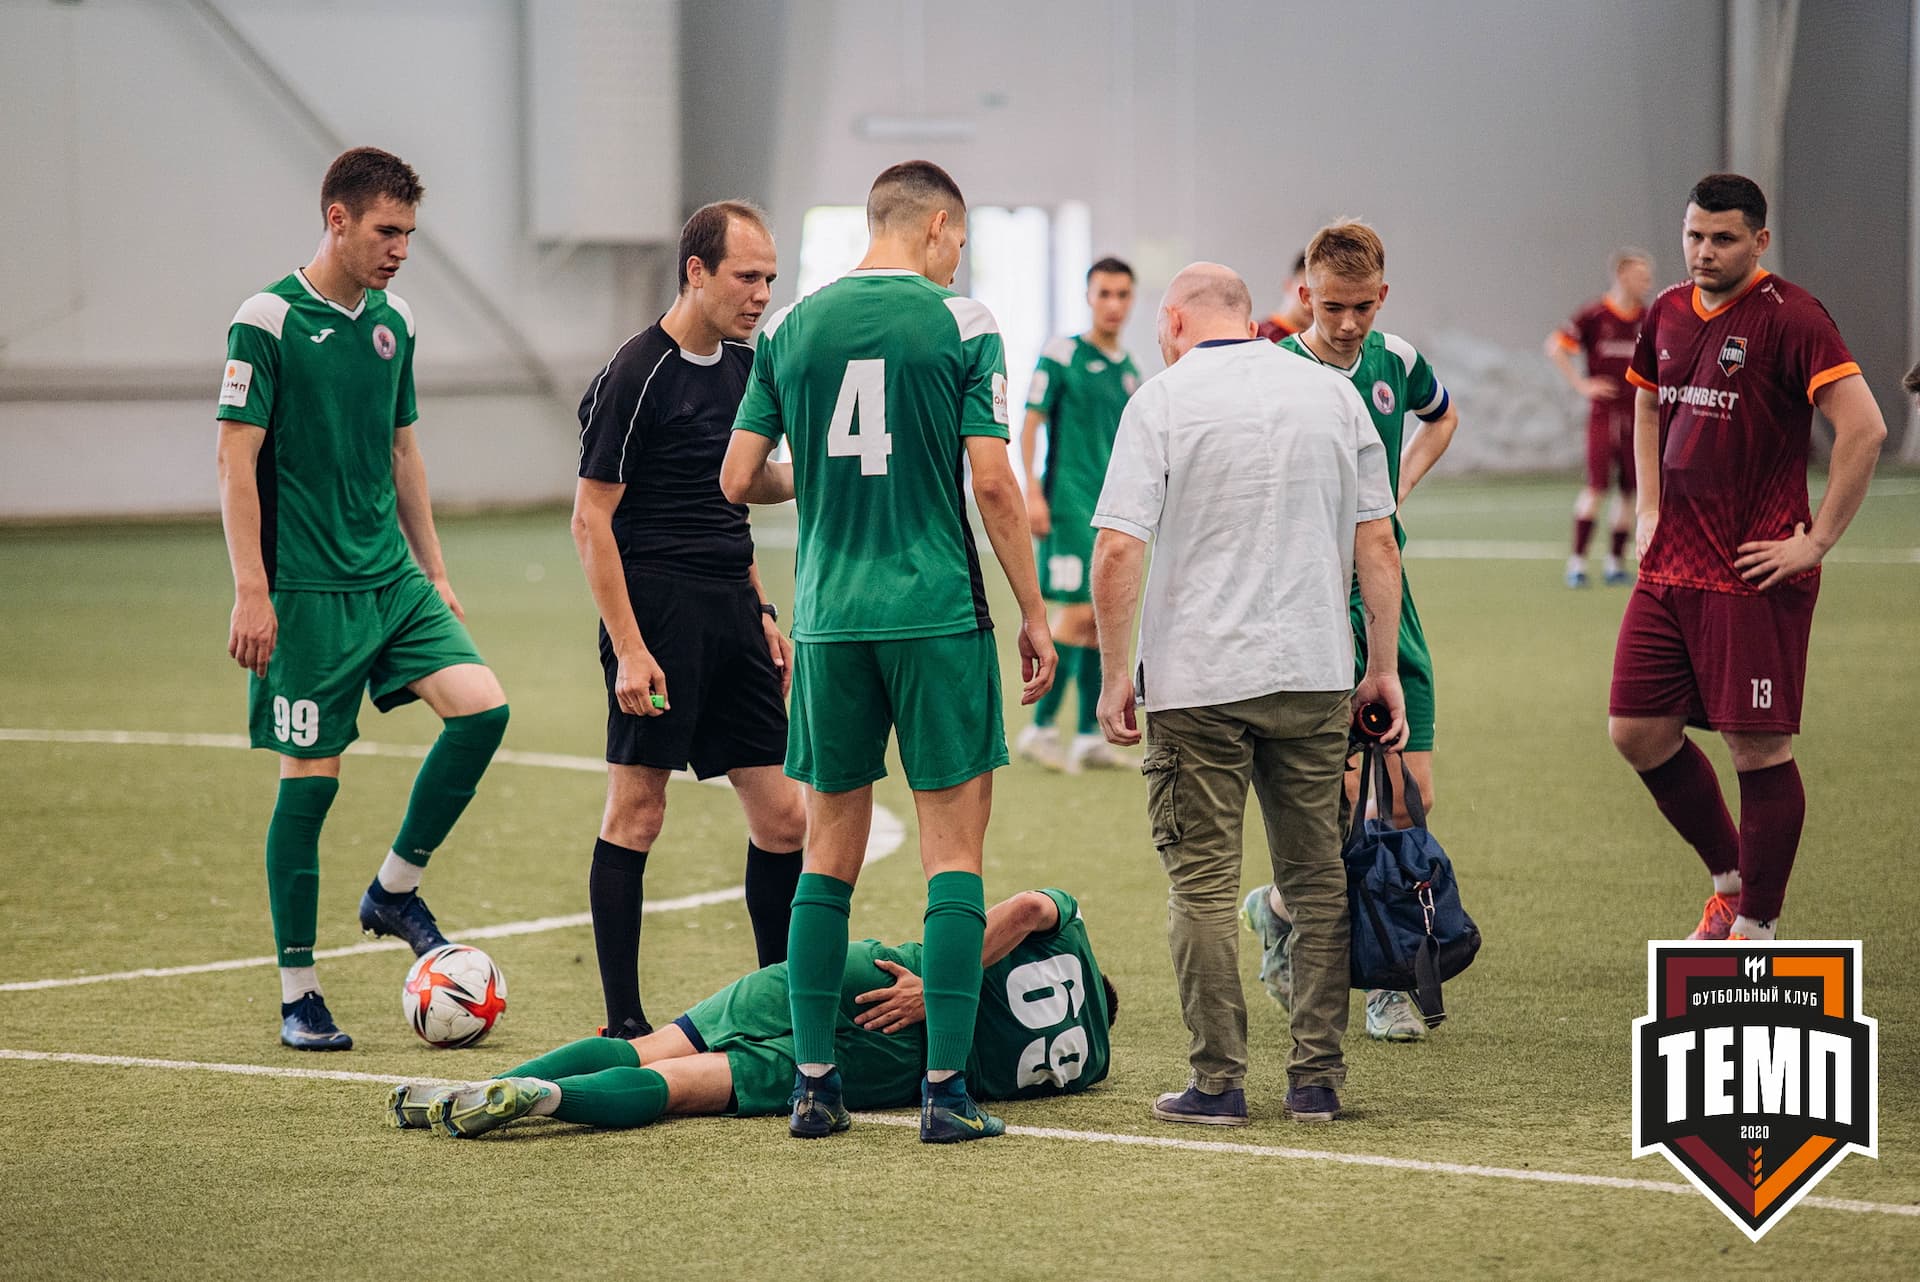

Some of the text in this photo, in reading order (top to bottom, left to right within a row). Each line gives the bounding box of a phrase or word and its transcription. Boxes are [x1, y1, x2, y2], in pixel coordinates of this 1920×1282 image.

[827, 358, 893, 476] 4
[273, 695, 319, 747] 99
[1750, 678, 1772, 709] 13
[1006, 953, 1089, 1089] 69
